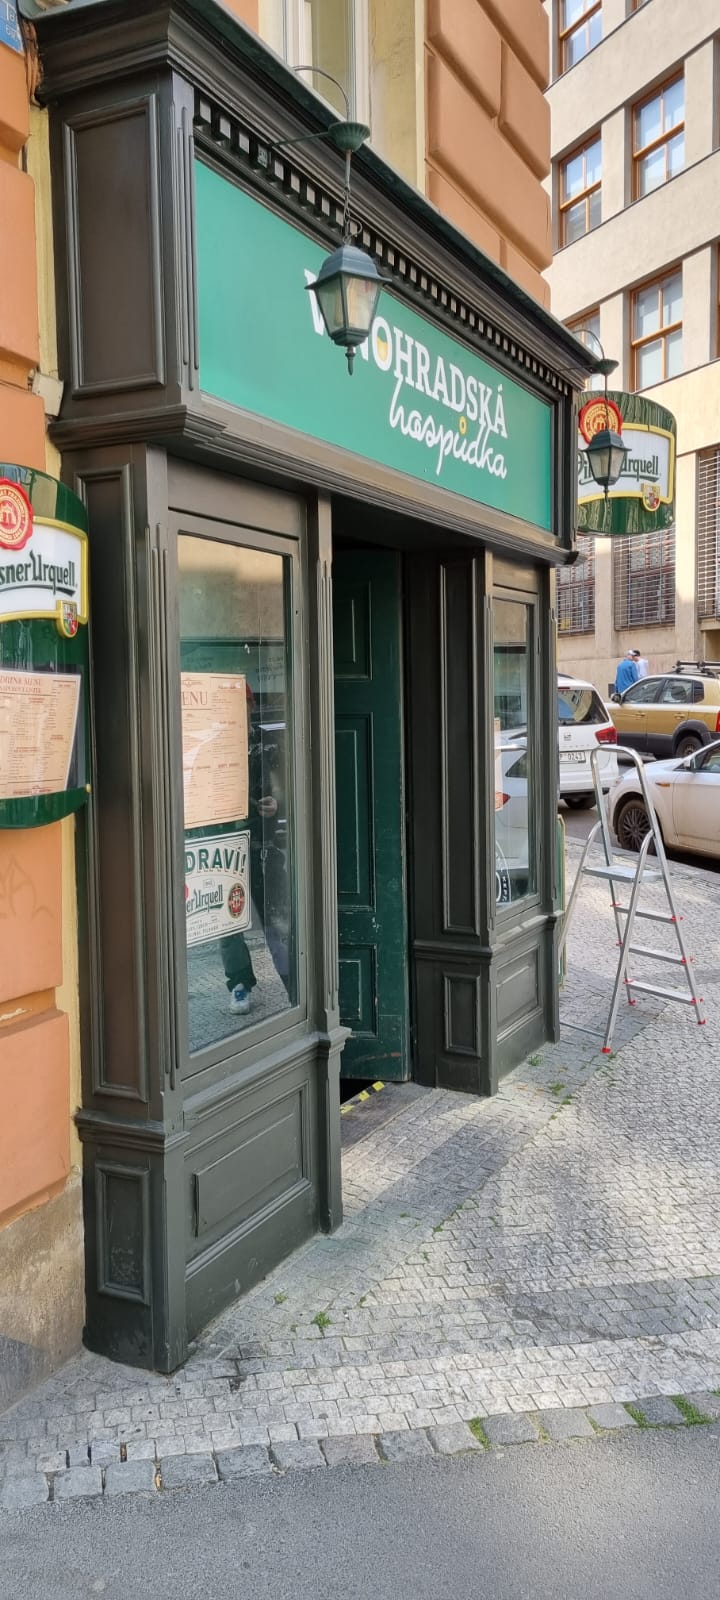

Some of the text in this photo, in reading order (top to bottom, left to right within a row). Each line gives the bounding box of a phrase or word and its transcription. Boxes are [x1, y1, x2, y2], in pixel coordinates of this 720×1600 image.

[304, 268, 508, 439] VOHRADSKÁ
[389, 378, 508, 480] hospůdka
[29, 550, 76, 596] Urquell
[193, 884, 224, 913] Urquell
